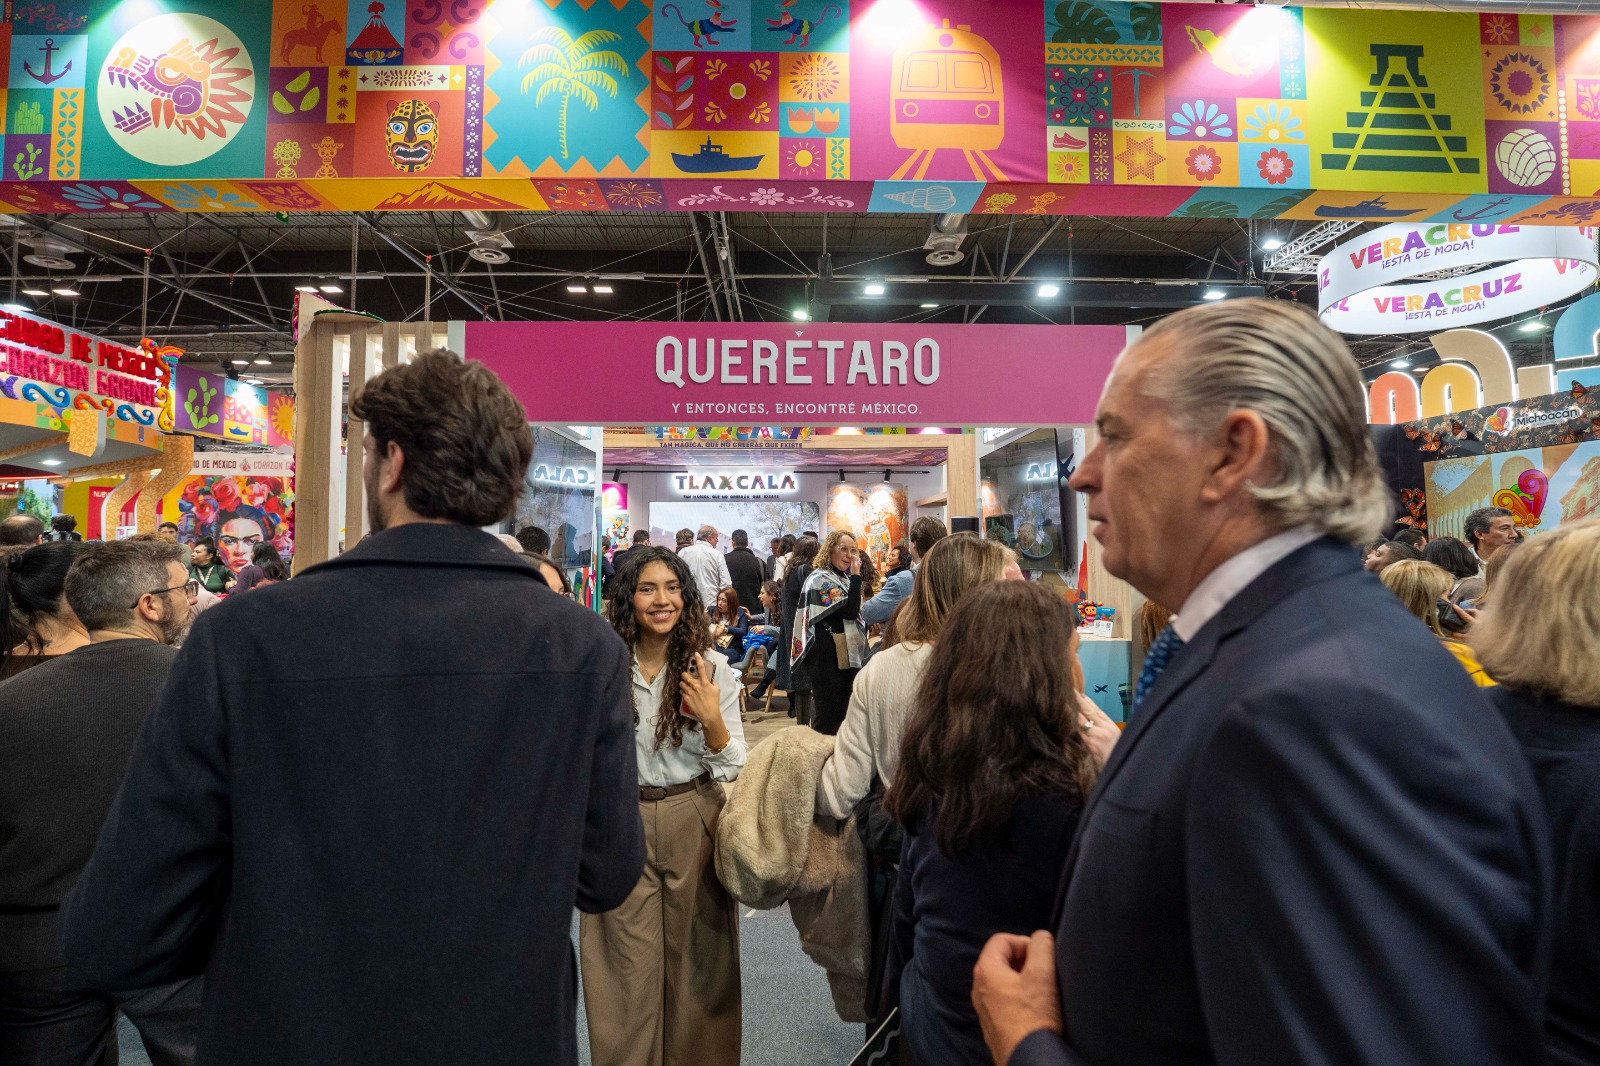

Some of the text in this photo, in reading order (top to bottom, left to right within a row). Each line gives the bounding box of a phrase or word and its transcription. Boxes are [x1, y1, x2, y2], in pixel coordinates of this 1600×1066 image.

[1381, 239, 1475, 270] ¡ESTA DE MODA!
[1373, 272, 1522, 314] VERACRUZ
[1435, 307, 1449, 317] DE
[1451, 300, 1485, 315] MODA!
[69, 333, 93, 363] DE
[655, 330, 941, 389] QUERÉTARO
[671, 400, 923, 415] Y ENTONCES, ENCONTRÉ MÉXICO.
[1516, 407, 1578, 426] Michoacán
[202, 460, 211, 469] DE
[675, 475, 796, 491] TLAXCALA
